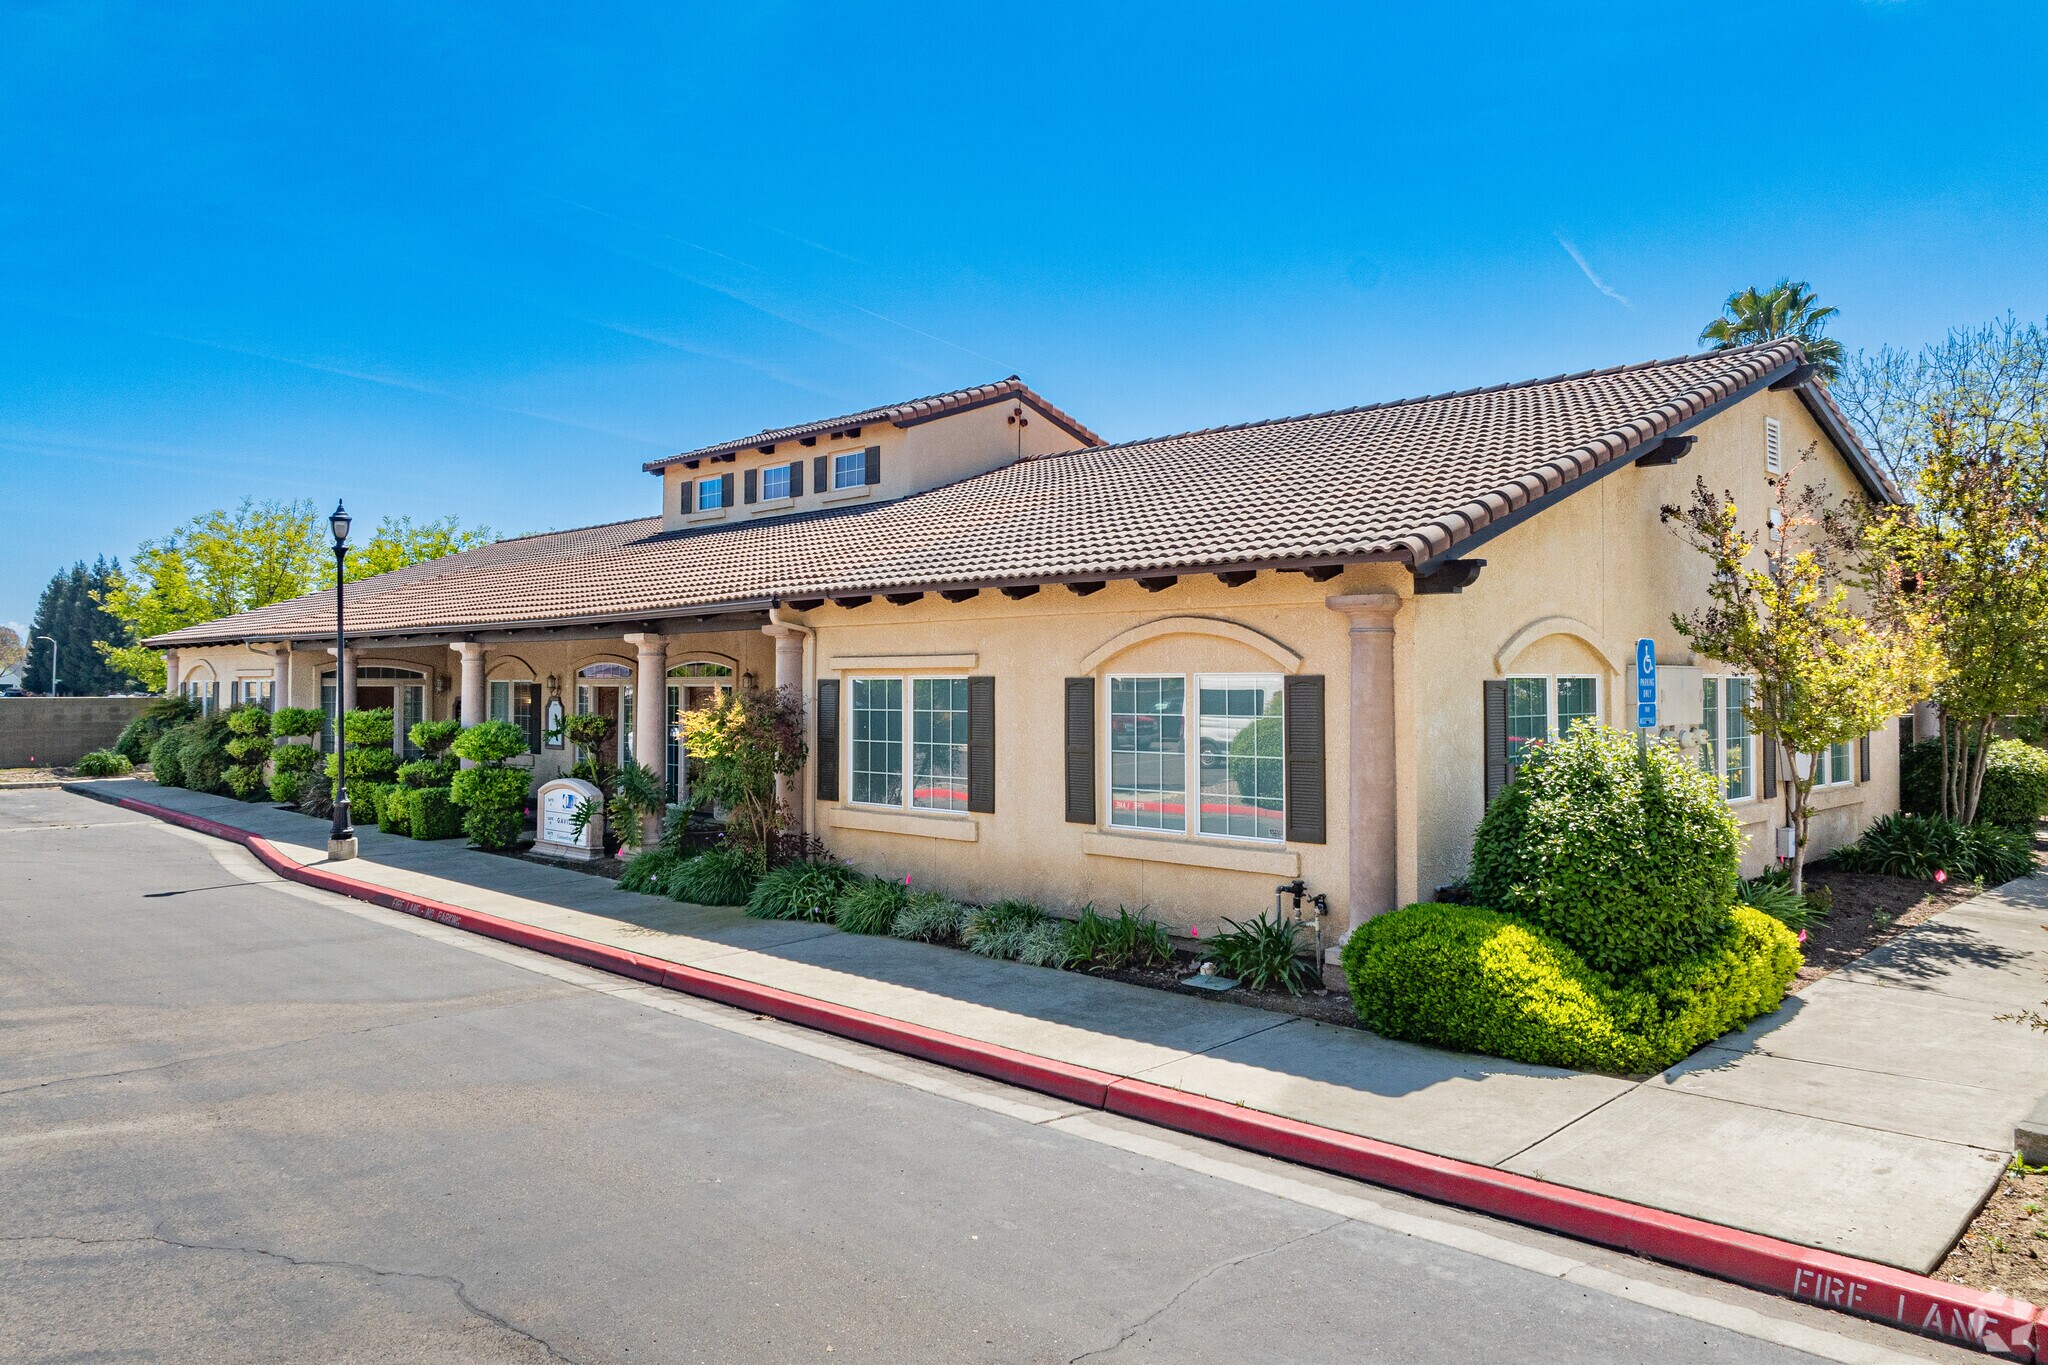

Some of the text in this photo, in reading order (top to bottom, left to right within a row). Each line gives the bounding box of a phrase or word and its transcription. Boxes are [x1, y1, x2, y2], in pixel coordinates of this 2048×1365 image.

[1640, 678, 1654, 687] PARKING
[1643, 689, 1652, 698] ONLY
[391, 898, 405, 909] FIRE
[1793, 1268, 1867, 1307] FIRE
[1897, 1294, 1998, 1345] LANE
